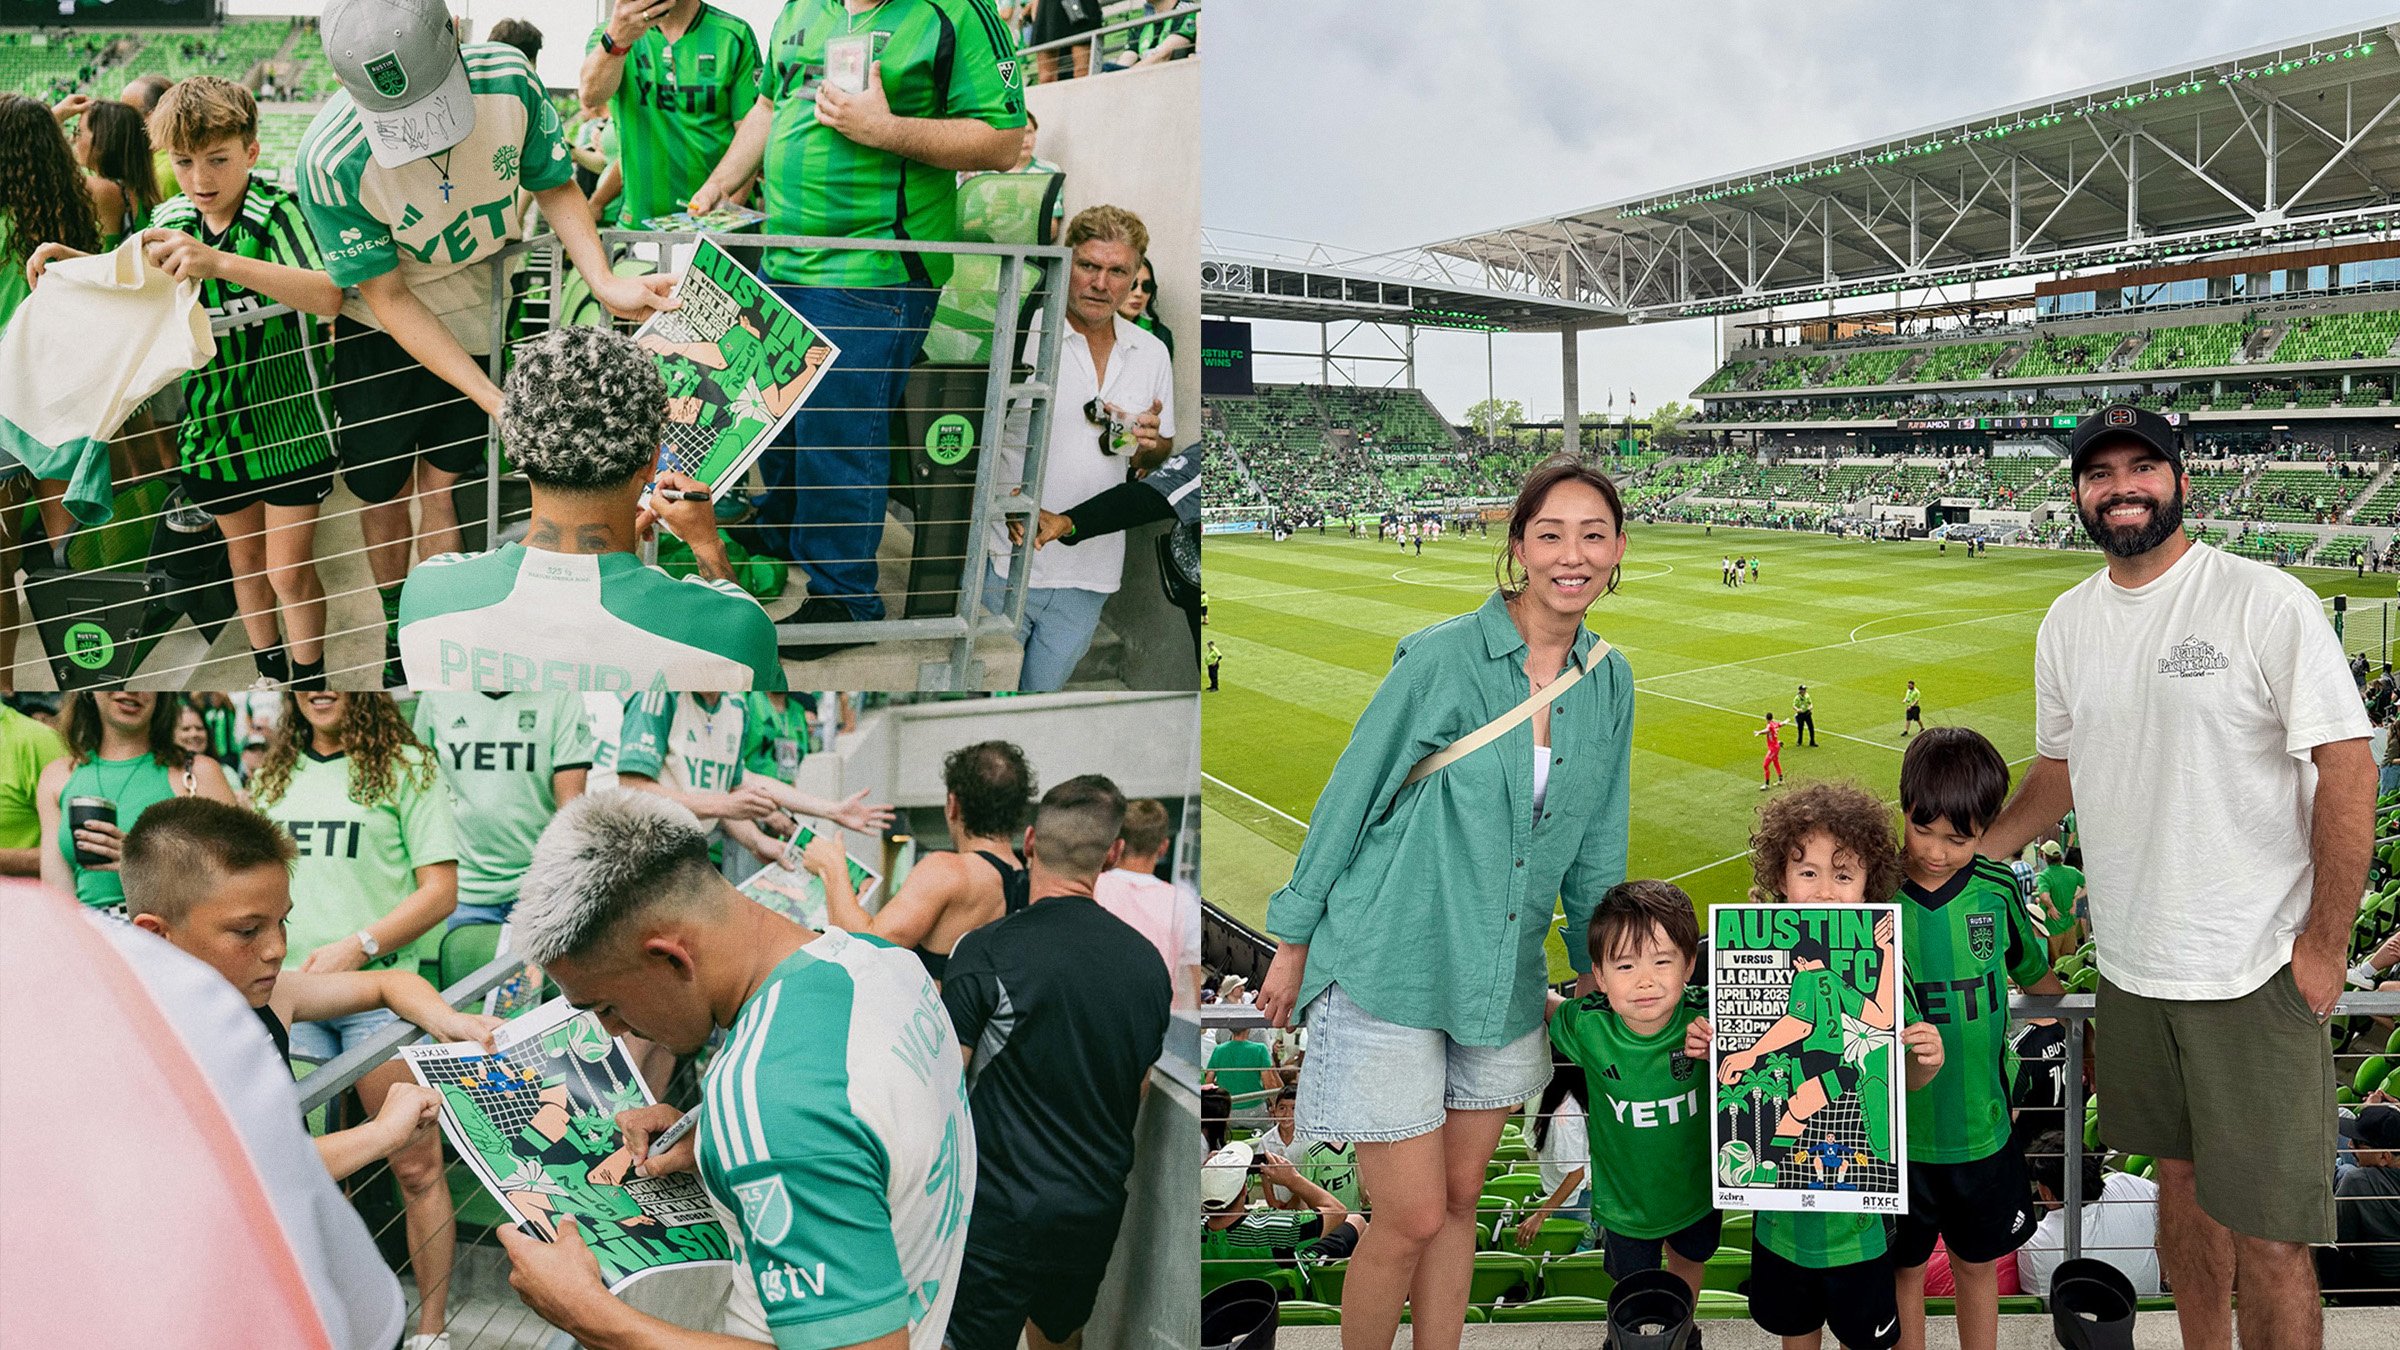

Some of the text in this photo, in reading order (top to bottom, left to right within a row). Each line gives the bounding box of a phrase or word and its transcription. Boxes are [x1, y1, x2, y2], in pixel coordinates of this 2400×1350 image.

[635, 76, 717, 114] YETI
[394, 195, 513, 264] YET
[324, 235, 391, 262] NETSPEND
[692, 240, 816, 358] AUSTIN
[701, 277, 729, 303] VERSUS
[681, 299, 723, 342] ATURDAY
[1201, 349, 1244, 359] USTIN FC
[1203, 358, 1232, 367] WINS
[448, 741, 536, 773] YETI
[286, 820, 362, 859] ETI
[1716, 910, 1875, 950] AUSTIN
[1733, 954, 1774, 964] VERSUS
[1830, 950, 1878, 994] FC
[1716, 969, 1796, 985] LA GALAXY
[1717, 988, 1790, 1001] APRIL 19 2025
[1717, 1000, 1789, 1015] SATURDAY
[1914, 970, 1999, 1025] ETI
[1717, 1019, 1771, 1033] 12:30 PM
[1717, 1036, 1737, 1052] Q2
[1606, 1088, 1698, 1129] YETI
[1319, 1167, 1355, 1191] YETI
[1862, 1196, 1899, 1208] ATXFC
[673, 1211, 713, 1223] VERSUS
